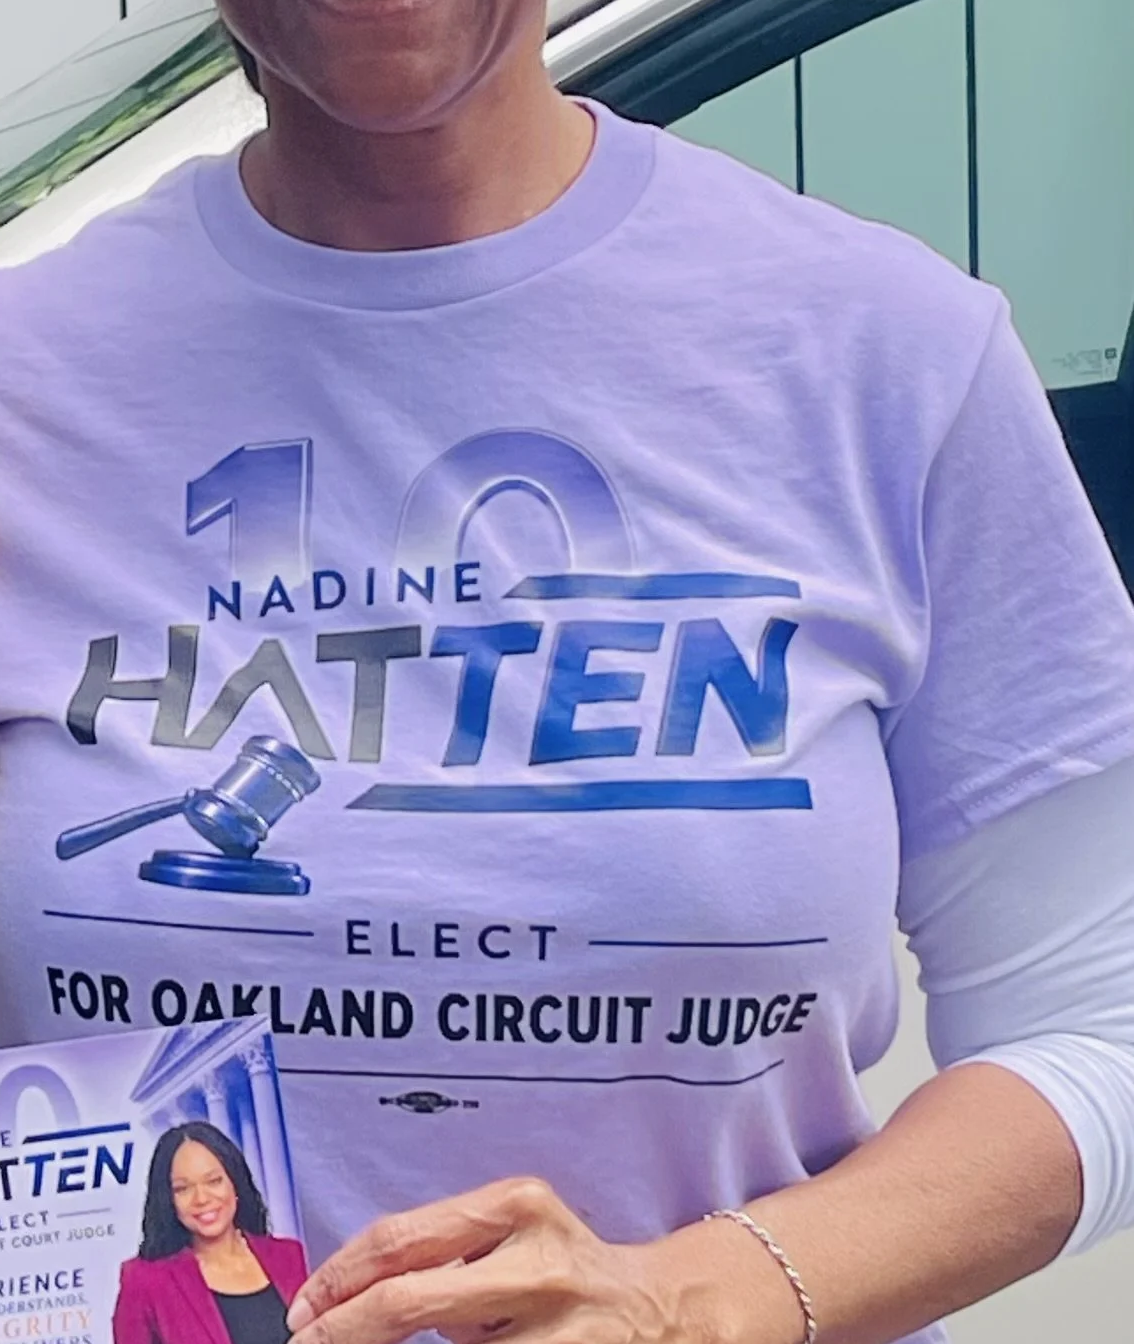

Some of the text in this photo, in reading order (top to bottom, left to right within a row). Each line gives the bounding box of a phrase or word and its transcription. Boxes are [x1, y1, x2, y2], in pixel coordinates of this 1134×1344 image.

[186, 427, 638, 586] 10
[206, 561, 483, 622] NADINE
[65, 616, 801, 767] HATTEN
[344, 917, 561, 961] ELECT
[46, 965, 818, 1046] FOR OAKLAND CIRCUIT JUDGE
[11, 1230, 61, 1249] COURT
[66, 1223, 116, 1242] JUDGE
